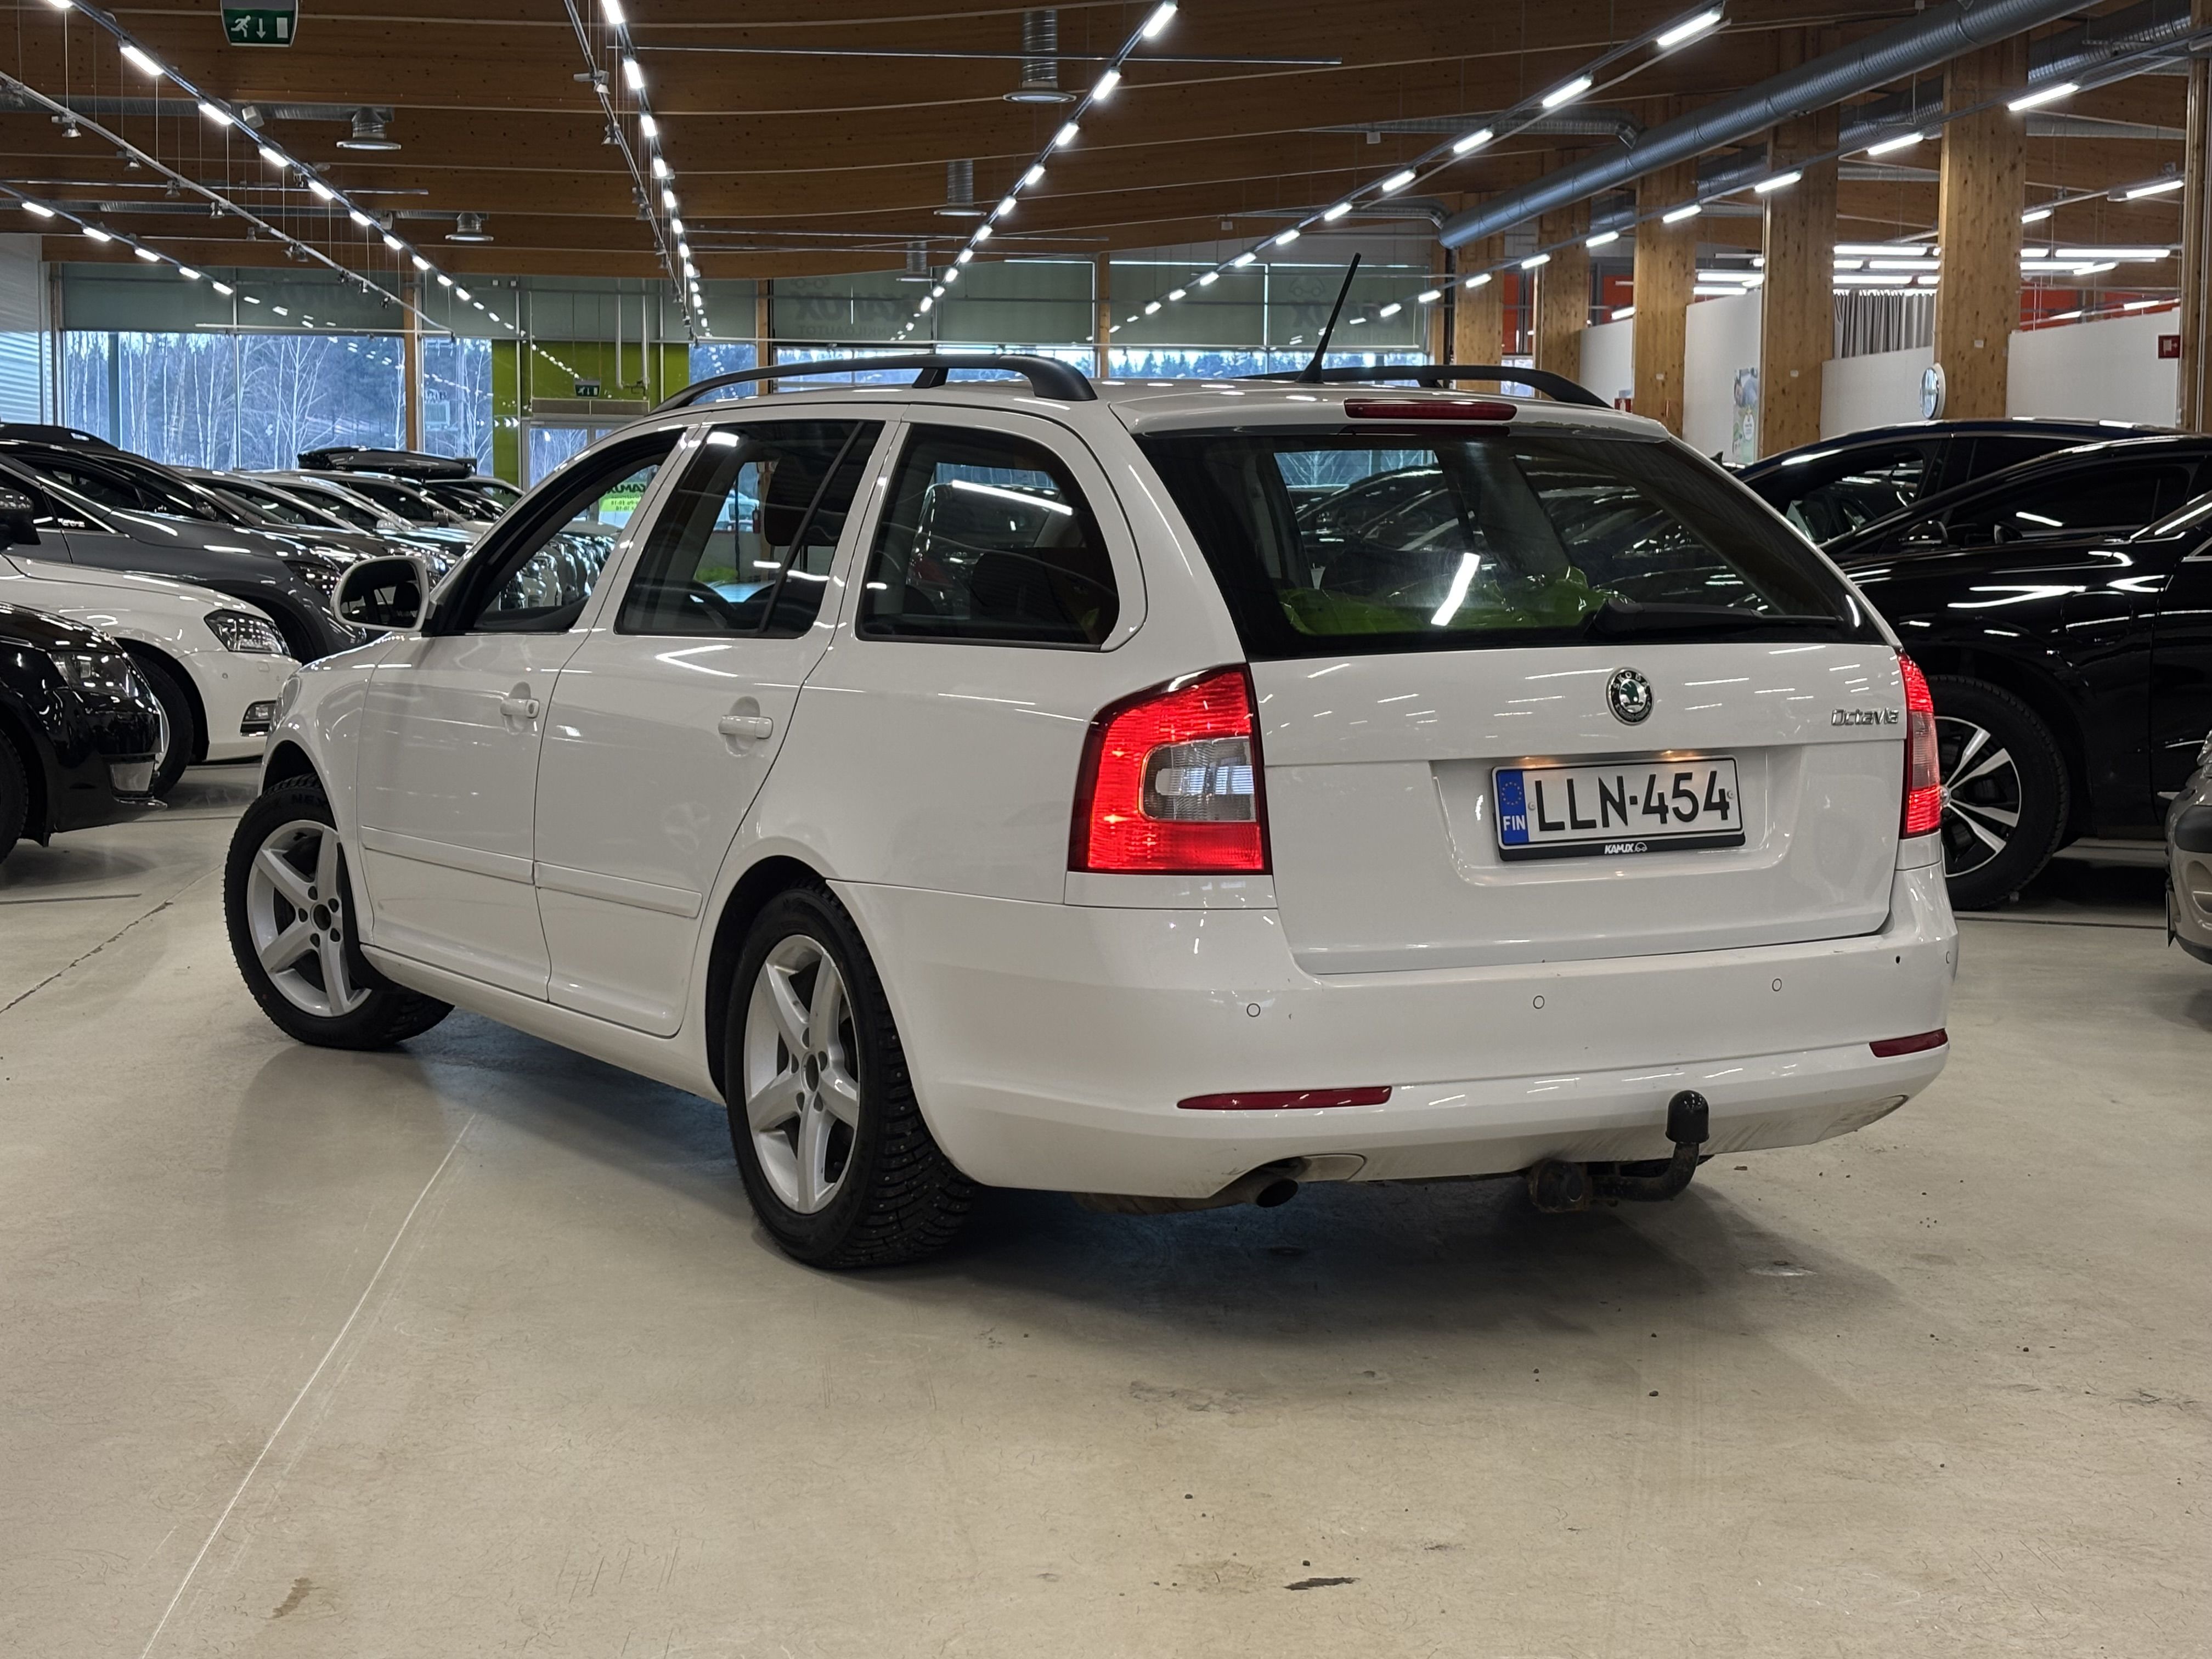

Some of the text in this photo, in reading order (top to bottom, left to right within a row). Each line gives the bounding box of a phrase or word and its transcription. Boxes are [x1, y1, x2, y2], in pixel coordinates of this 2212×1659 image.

[1831, 707, 1899, 726] Octavia
[1535, 771, 1730, 831] LLN-454
[1503, 815, 1526, 831] FIN
[1604, 843, 1634, 854] KAMUX
